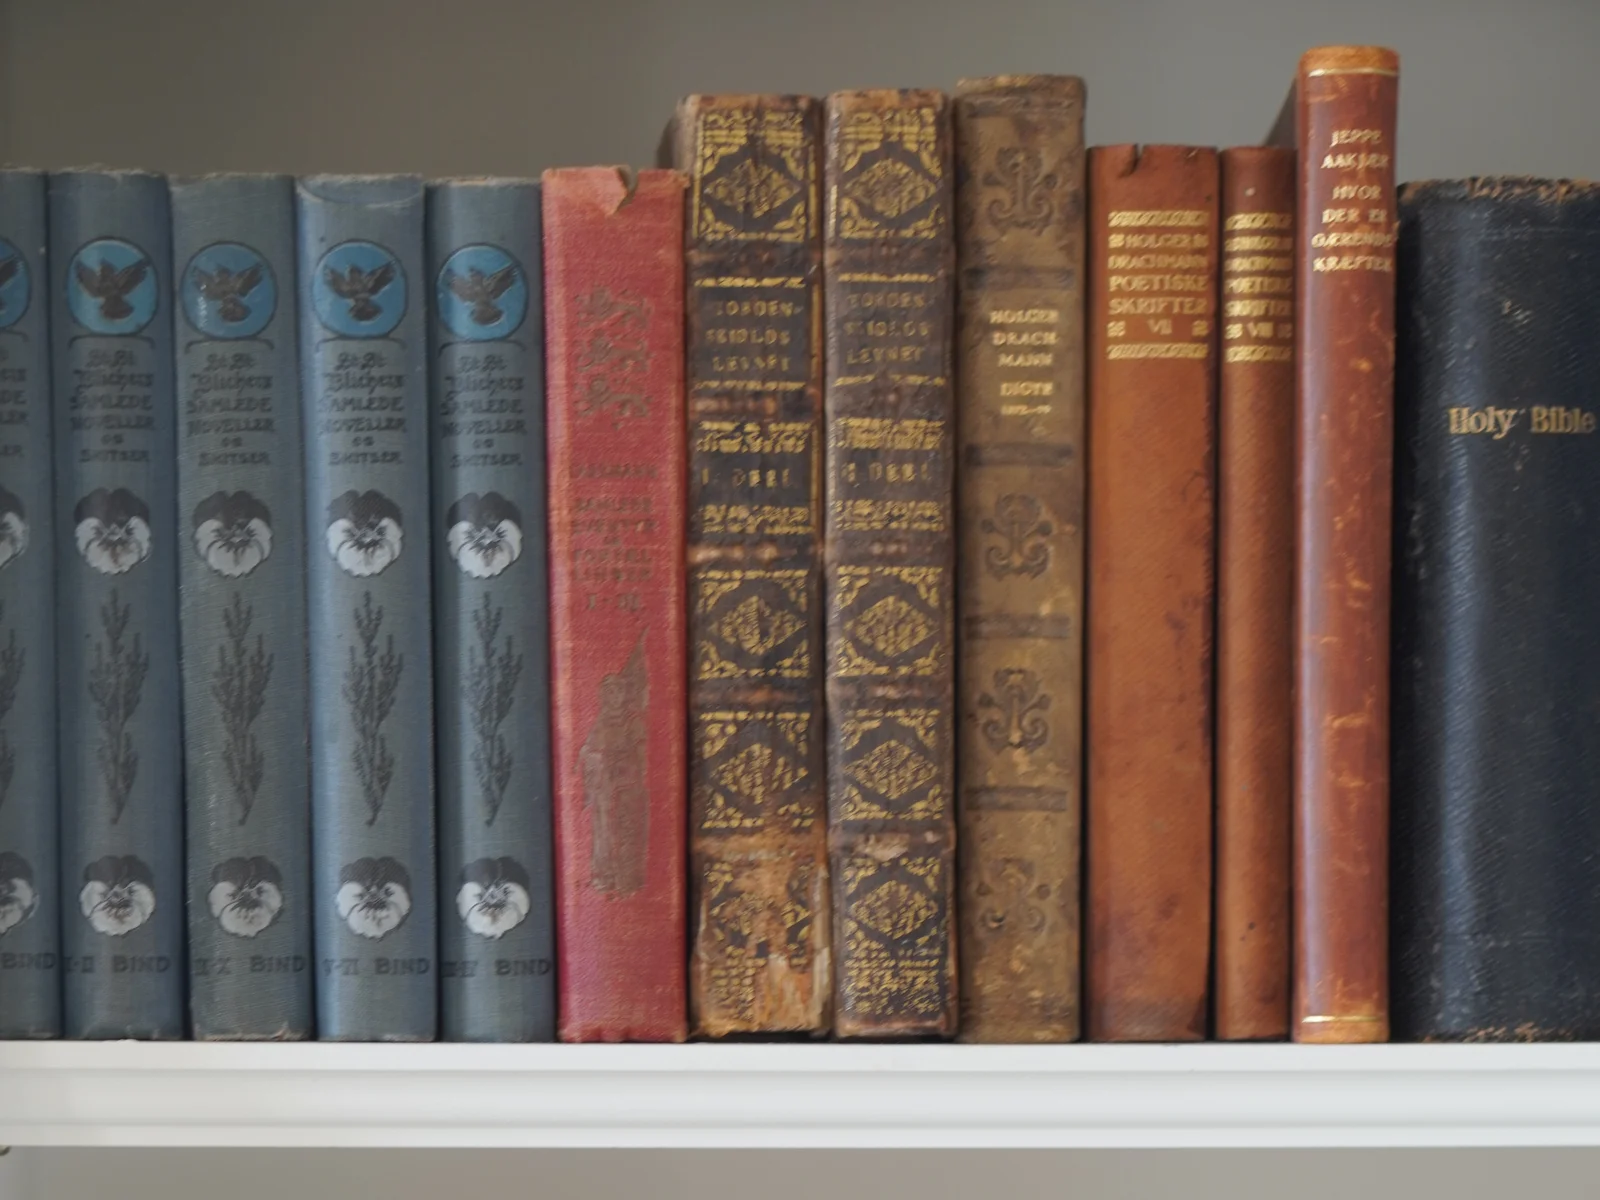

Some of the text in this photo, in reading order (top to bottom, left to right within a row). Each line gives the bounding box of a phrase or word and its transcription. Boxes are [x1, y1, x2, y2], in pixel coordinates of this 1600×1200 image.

[1330, 128, 1382, 147] JEPPE
[1332, 185, 1382, 200] HVOR
[1321, 208, 1361, 224] DER
[1109, 275, 1209, 292] POETISKE
[1108, 296, 1208, 315] SKRIFTER
[1447, 405, 1597, 439] Holy Bible
[1, 953, 56, 969] BIND
[112, 955, 171, 973] BIND
[250, 954, 306, 973] BIND
[373, 957, 430, 975] BIND
[495, 958, 552, 976] BIND
